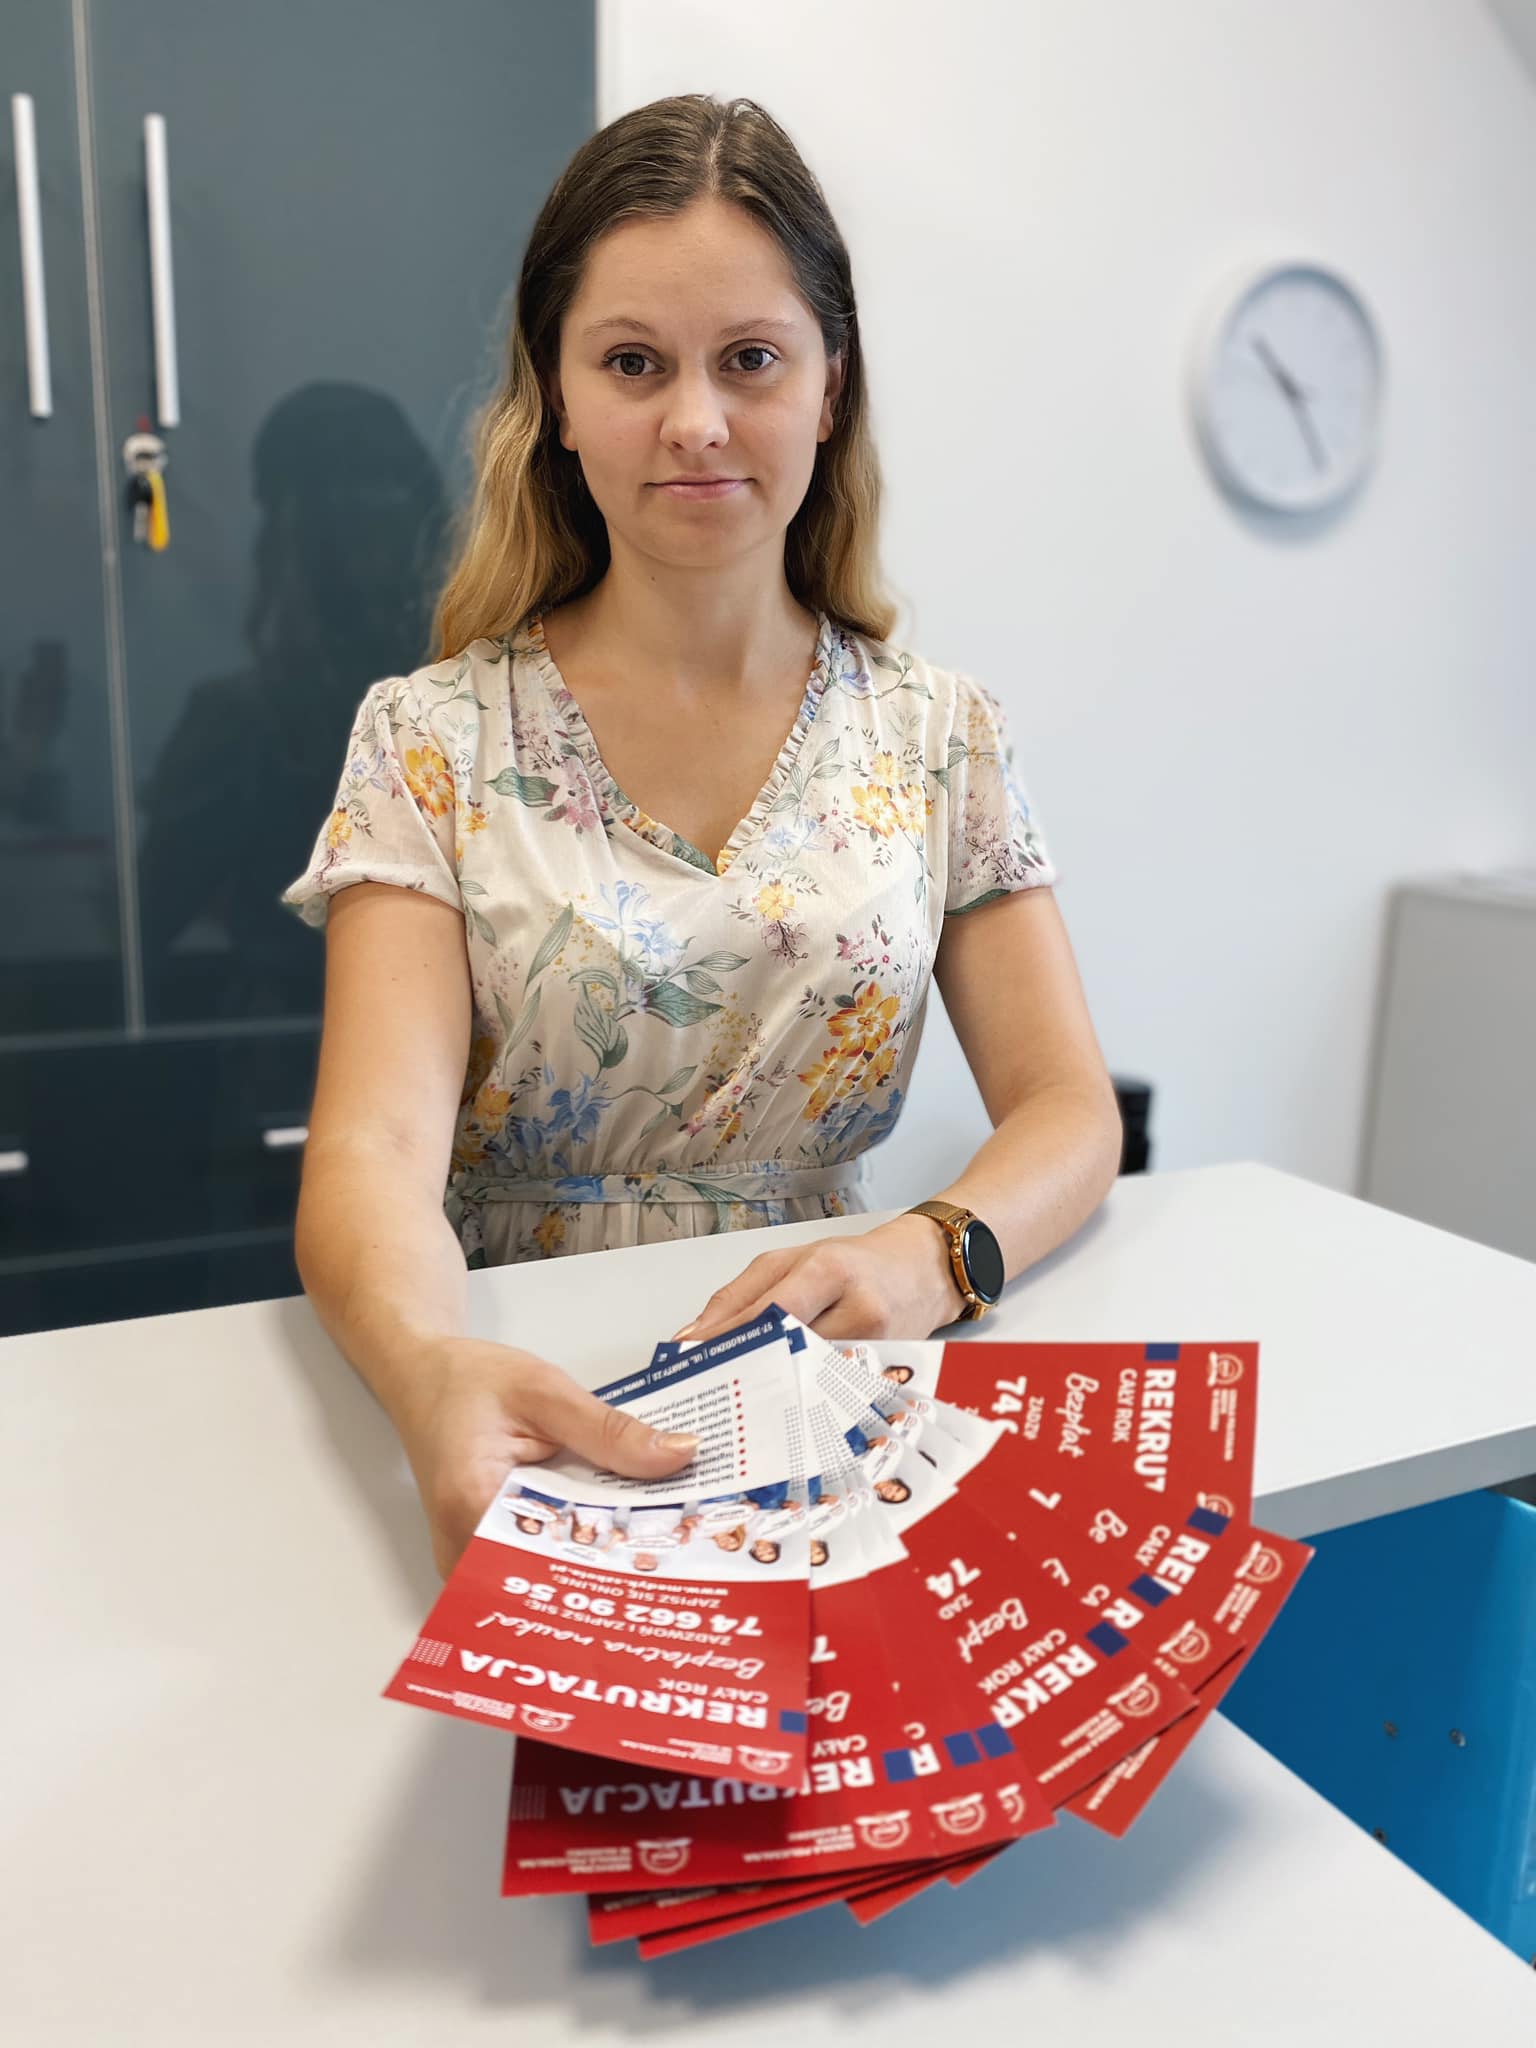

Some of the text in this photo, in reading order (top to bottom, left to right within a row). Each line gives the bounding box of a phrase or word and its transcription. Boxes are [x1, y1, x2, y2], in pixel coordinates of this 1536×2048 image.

[1113, 1368, 1137, 1442] CAŁY ROK
[926, 1559, 980, 1600] 74
[503, 1577, 762, 1636] 74 662 90 56
[561, 1610, 625, 1630] ZAPISZ
[476, 1612, 764, 1679] Bezpłatna nauka!
[639, 1626, 731, 1645] ZADZWOŃ
[979, 1629, 1066, 1694] CAŁY ROK
[461, 1650, 767, 1728] REKRUTACJA
[659, 1678, 768, 1704] CAŁY ROK
[813, 1735, 867, 1757] CAŁY
